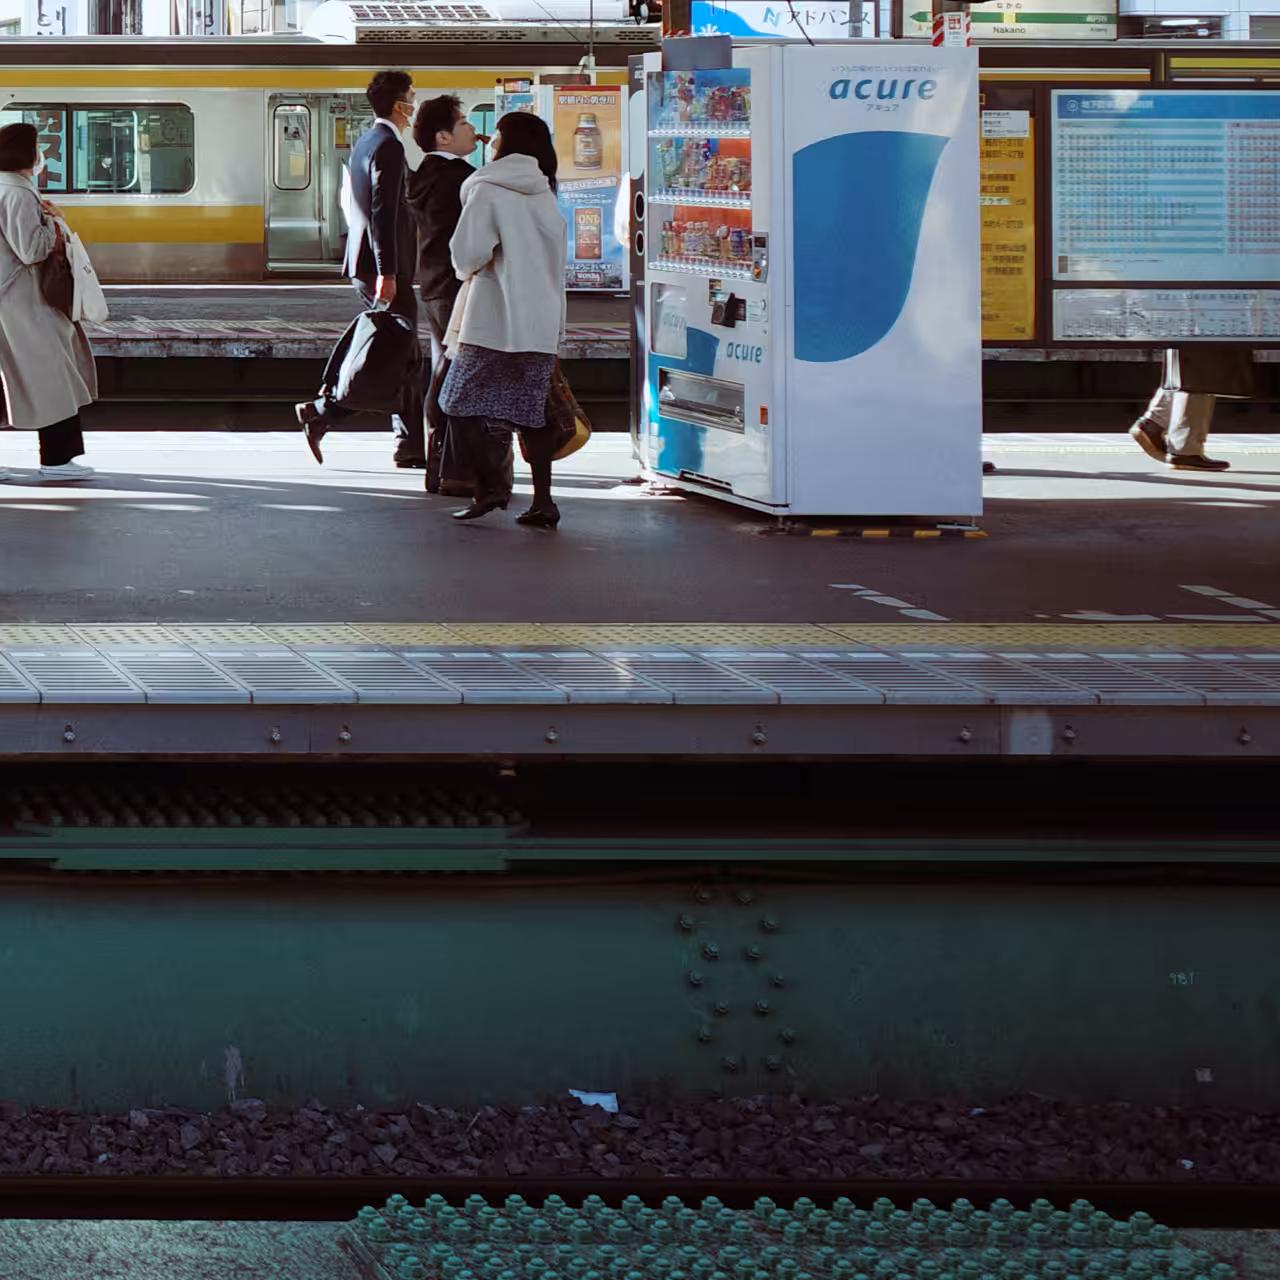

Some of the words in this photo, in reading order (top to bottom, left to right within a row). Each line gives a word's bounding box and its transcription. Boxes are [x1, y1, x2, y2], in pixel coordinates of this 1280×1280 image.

[993, 26, 1026, 34] Nakano
[829, 79, 937, 100] acure
[726, 342, 762, 363] acure
